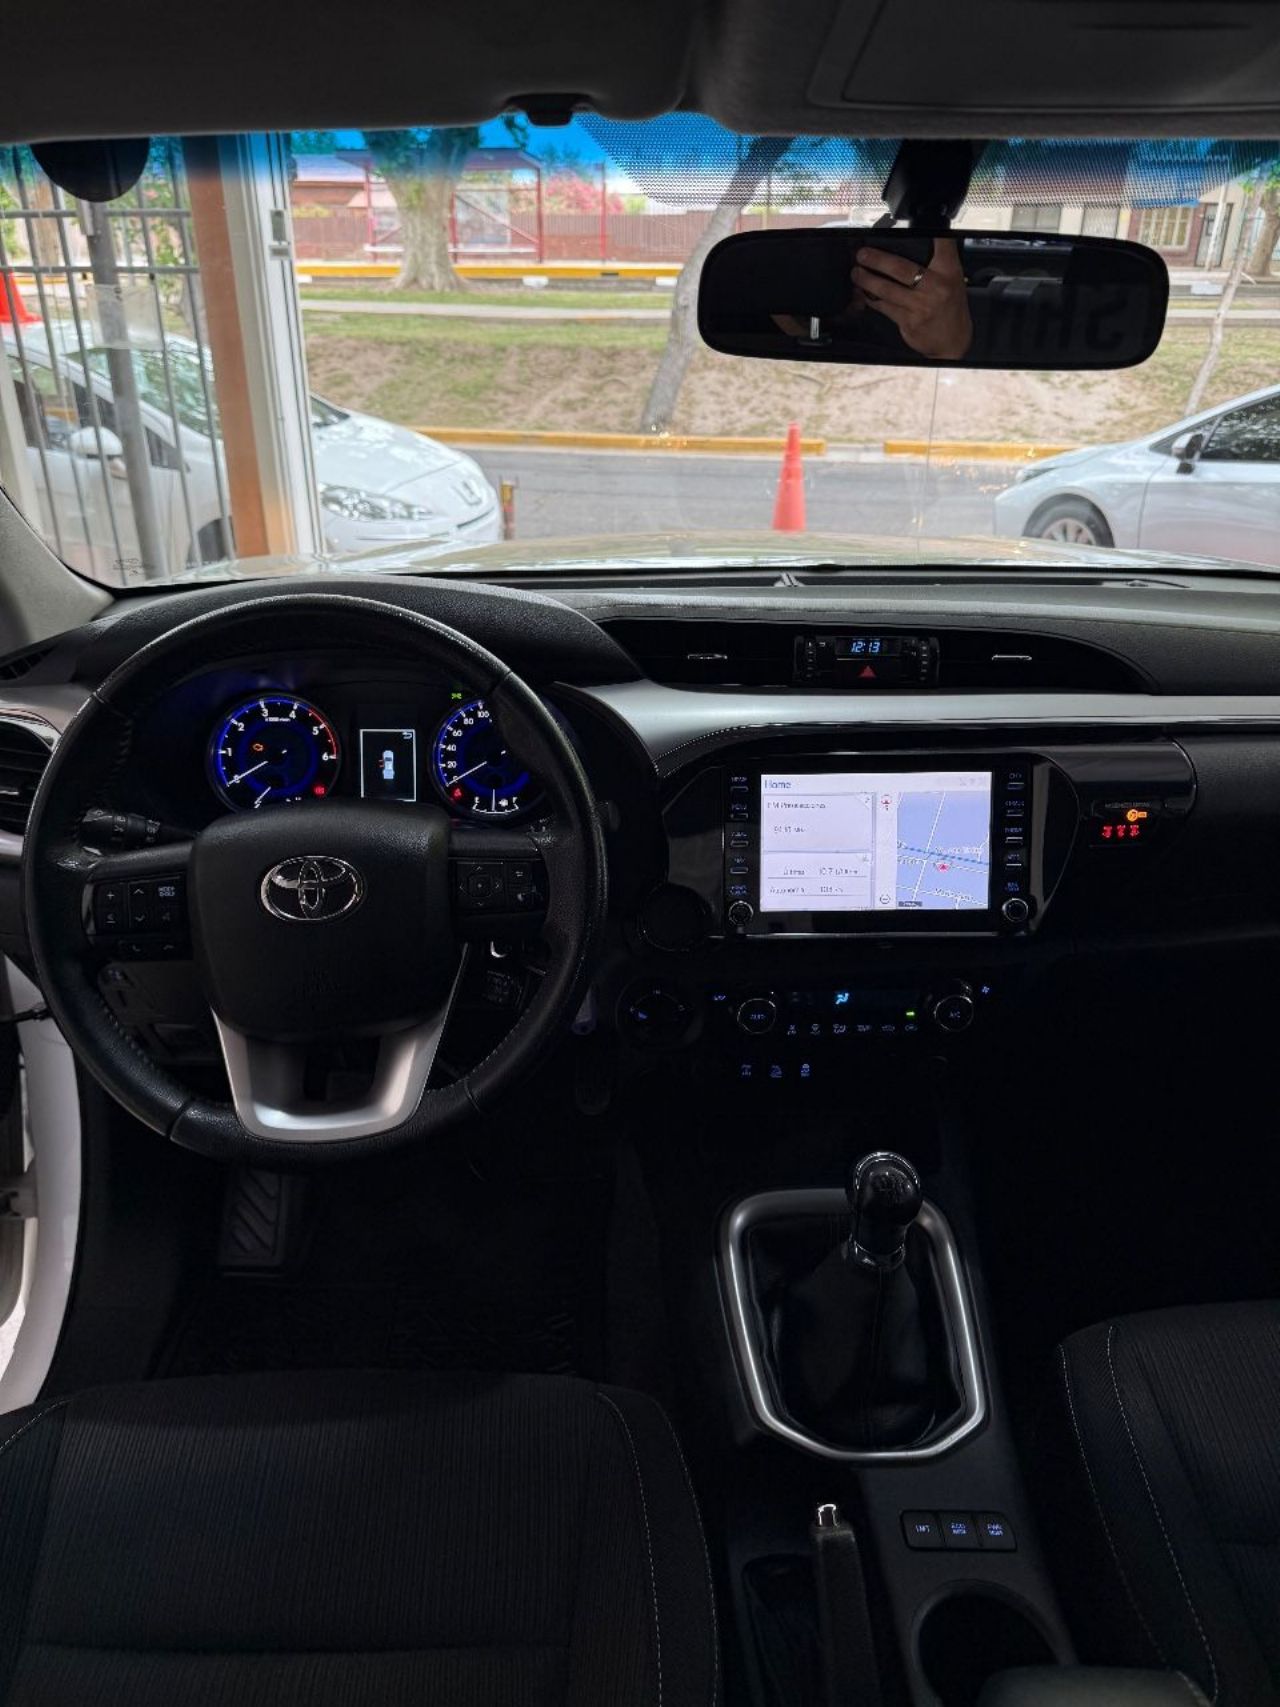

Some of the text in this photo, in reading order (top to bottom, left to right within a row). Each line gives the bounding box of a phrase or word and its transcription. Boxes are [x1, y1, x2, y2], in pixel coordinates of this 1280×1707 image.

[850, 642, 881, 653] 12:13
[262, 708, 269, 718] 3
[289, 709, 296, 719] 4
[477, 710, 490, 718] 100
[238, 722, 245, 732] 2
[312, 726, 320, 736] 5
[226, 747, 232, 756] 1
[321, 752, 329, 761] 6
[764, 779, 792, 789] Home
